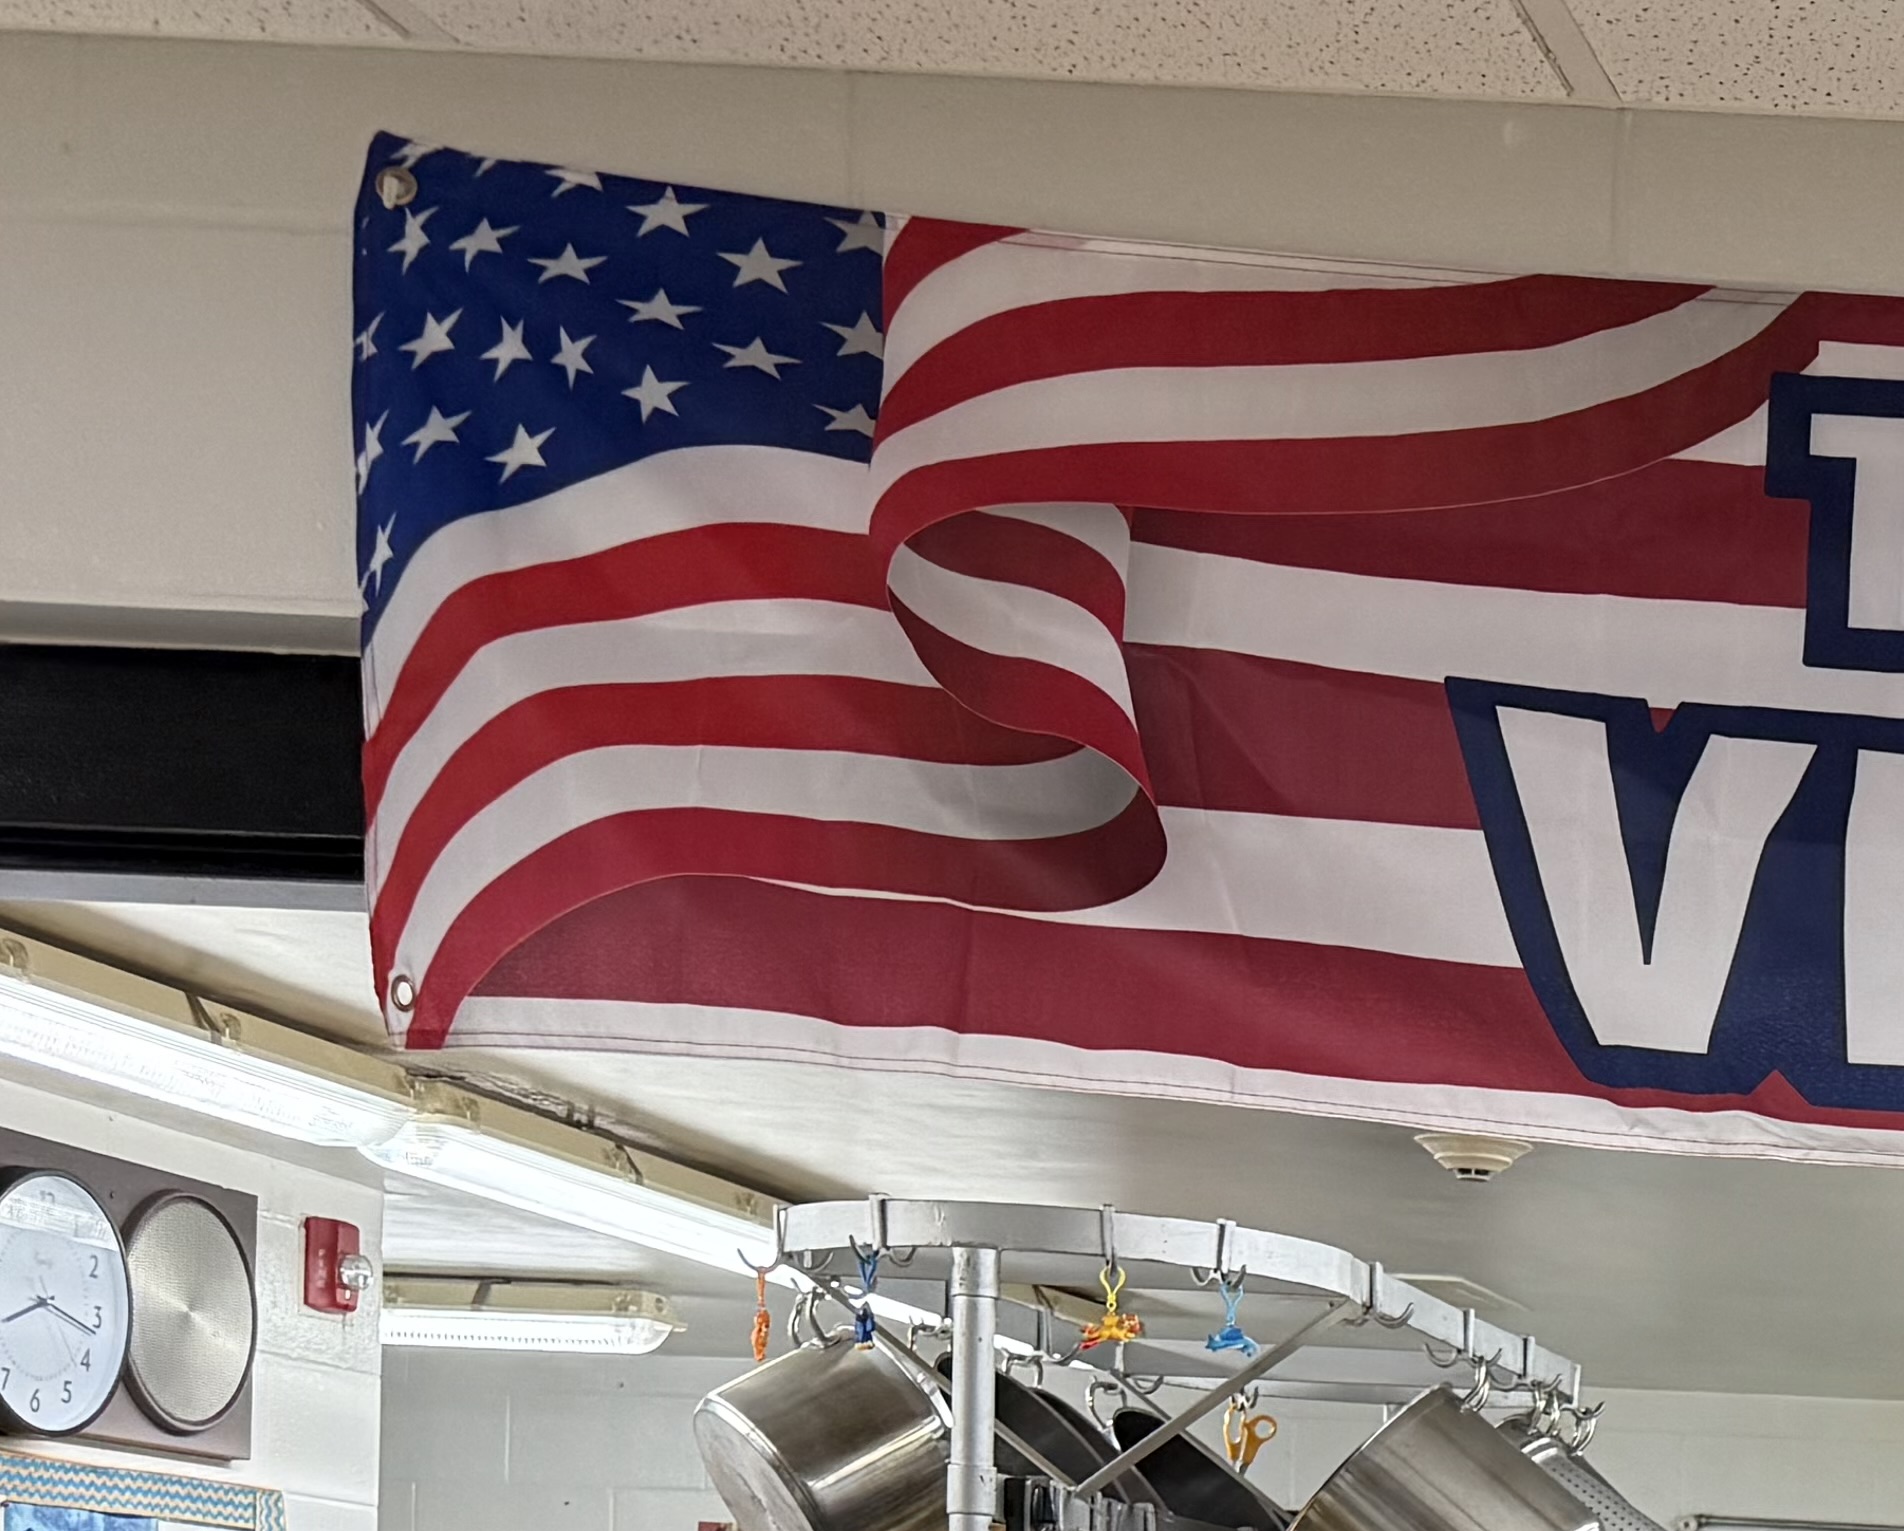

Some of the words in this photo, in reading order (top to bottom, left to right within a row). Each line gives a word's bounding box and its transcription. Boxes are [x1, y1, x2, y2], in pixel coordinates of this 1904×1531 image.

[88, 1254, 99, 1279] 2
[93, 1305, 103, 1329] 3
[79, 1348, 92, 1372] 4
[1, 1367, 11, 1391] 7
[29, 1388, 41, 1413] 6
[60, 1380, 73, 1403] 5
